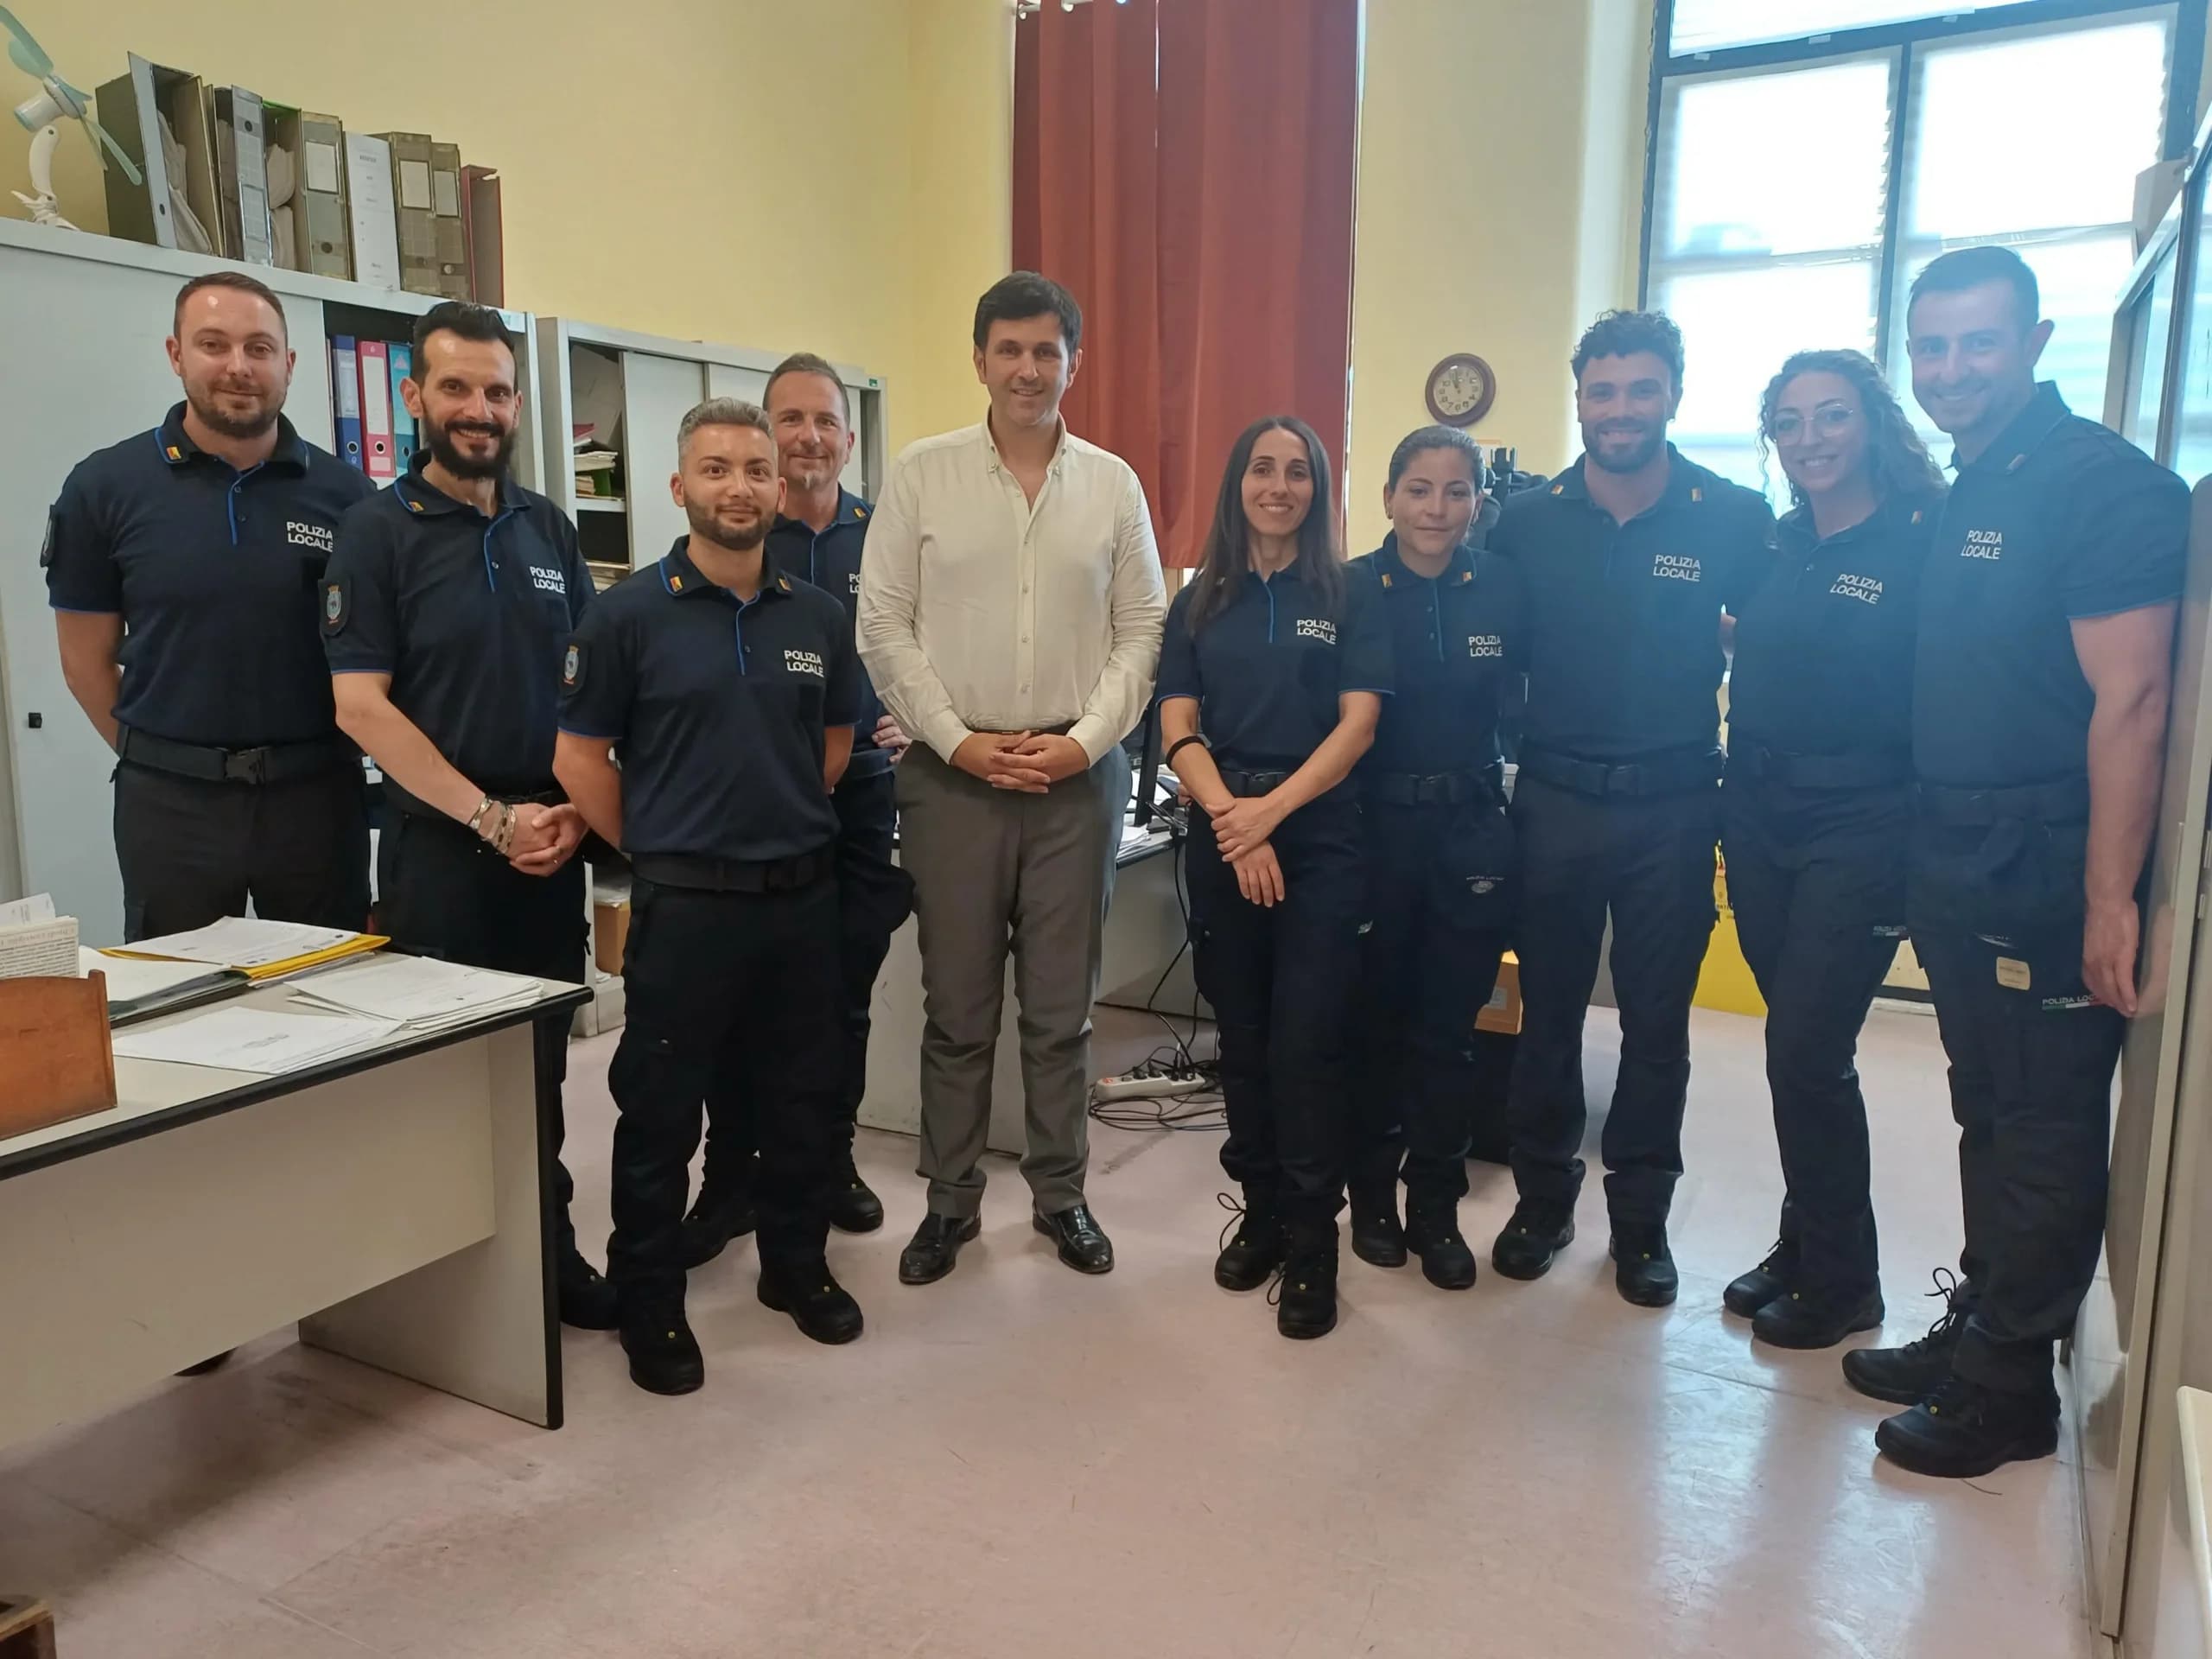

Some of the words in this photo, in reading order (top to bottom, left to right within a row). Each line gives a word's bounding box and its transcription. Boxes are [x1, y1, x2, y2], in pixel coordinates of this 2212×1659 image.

[286, 522, 334, 541] POLIZIA
[1966, 530, 2002, 545] POLIZIA
[288, 532, 334, 553] LOCALE
[1961, 544, 2001, 559] LOCALE
[1655, 554, 1700, 570] POLIZIA
[530, 566, 564, 582] POLIZIA
[1653, 566, 1700, 582] LOCALE
[533, 578, 566, 594] LOCALE
[1837, 574, 1883, 594] POLIZIA
[1829, 583, 1880, 605] LOCALE
[1297, 619, 1337, 634] POLIZIA
[1297, 627, 1336, 645] LOCALE
[1468, 635, 1502, 646] POLIZIA
[784, 650, 823, 665] POLIZIA
[1470, 646, 1503, 657] LOCALE
[786, 661, 824, 678] LOCALE
